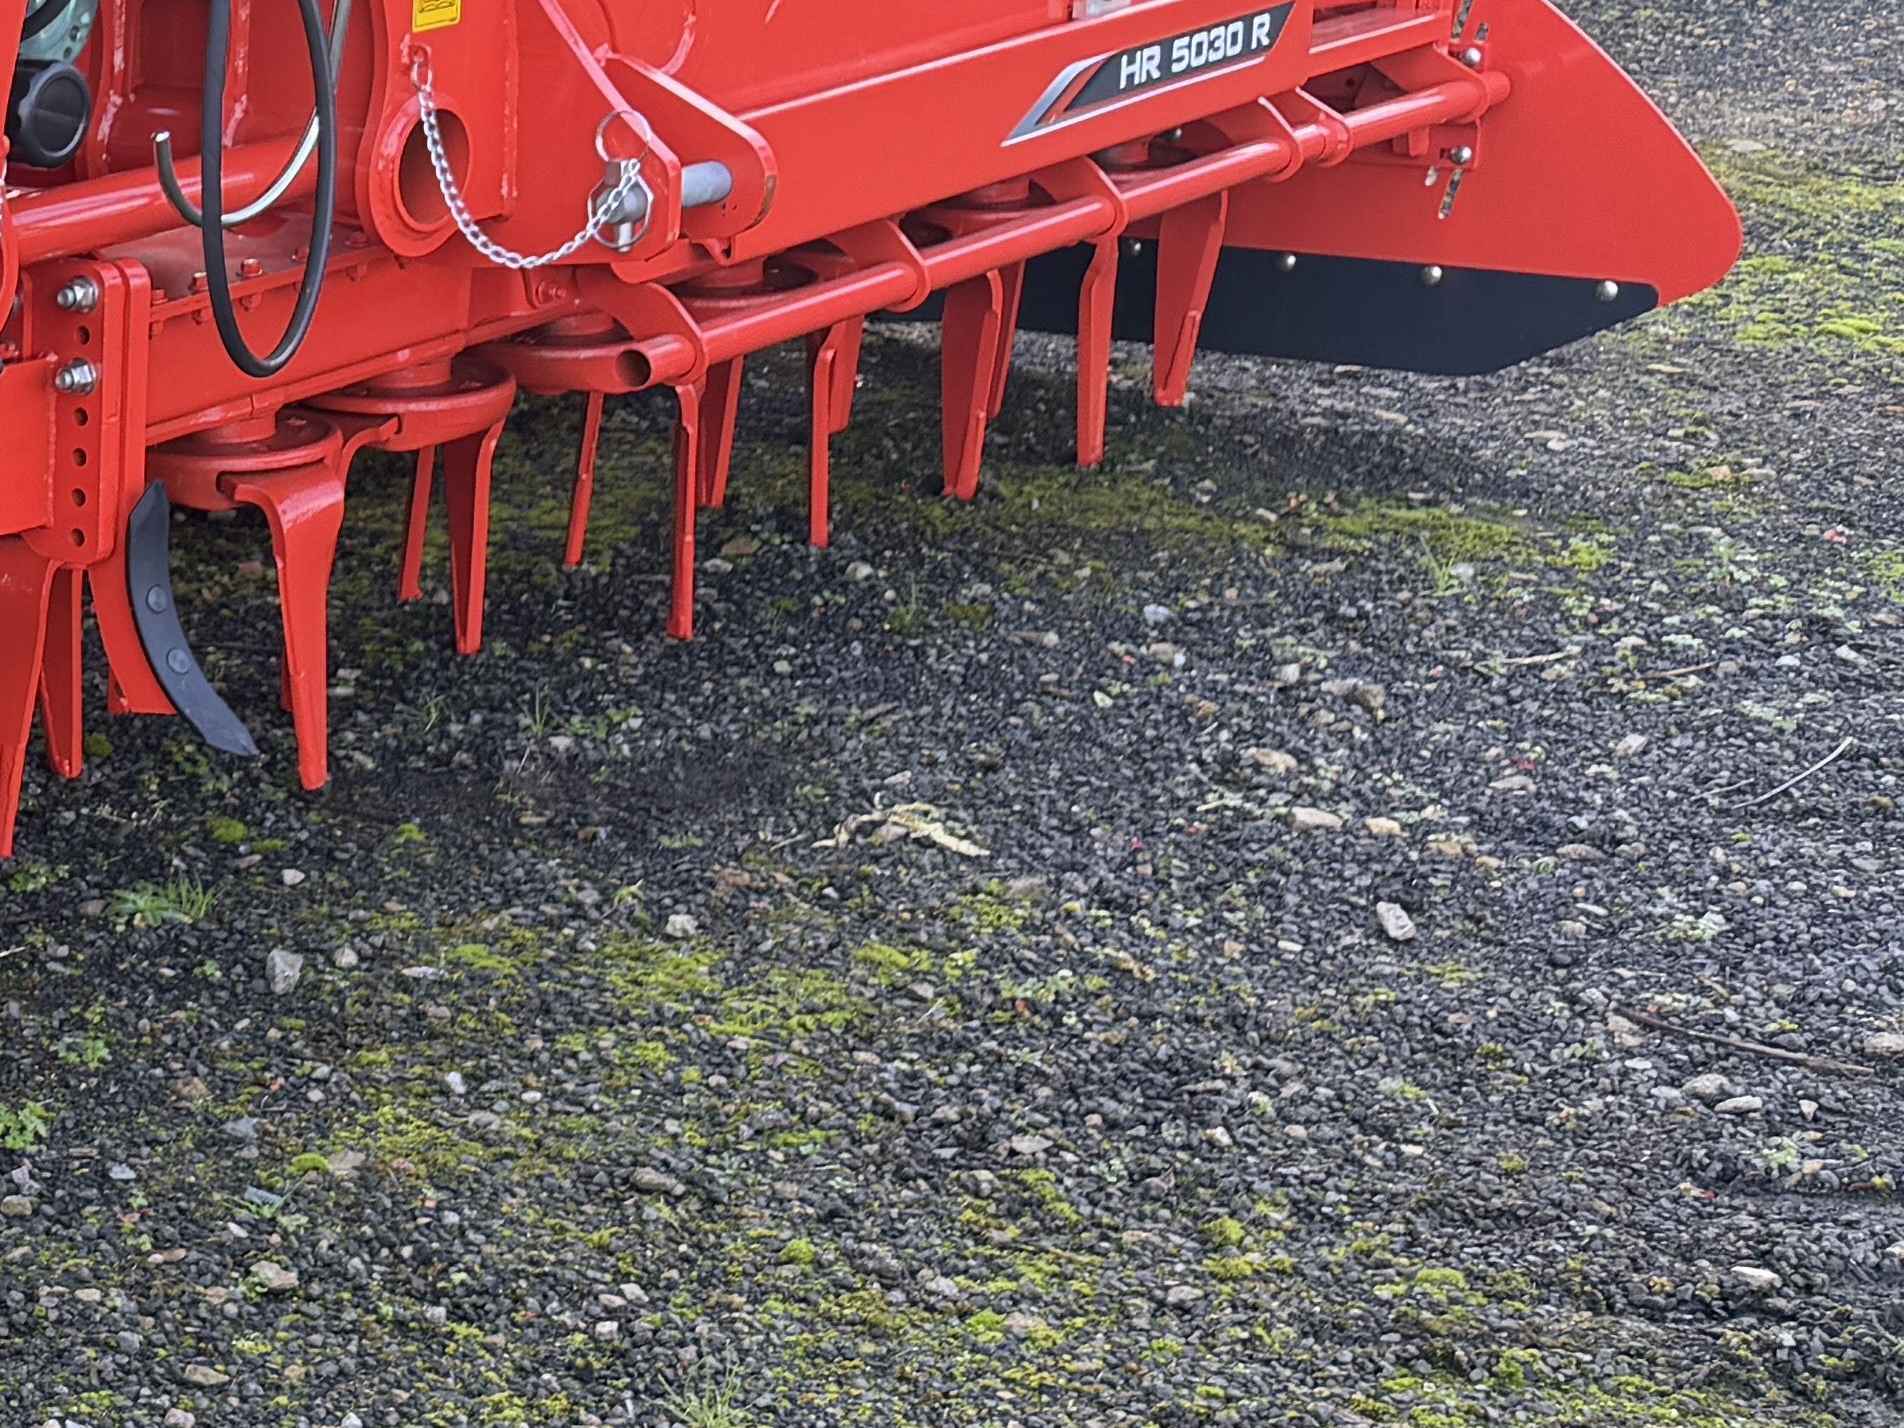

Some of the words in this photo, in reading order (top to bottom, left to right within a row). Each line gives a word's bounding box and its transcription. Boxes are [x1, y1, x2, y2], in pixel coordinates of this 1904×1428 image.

[1120, 46, 1161, 89] HR
[1171, 21, 1243, 73] 5030
[1251, 12, 1271, 50] R
